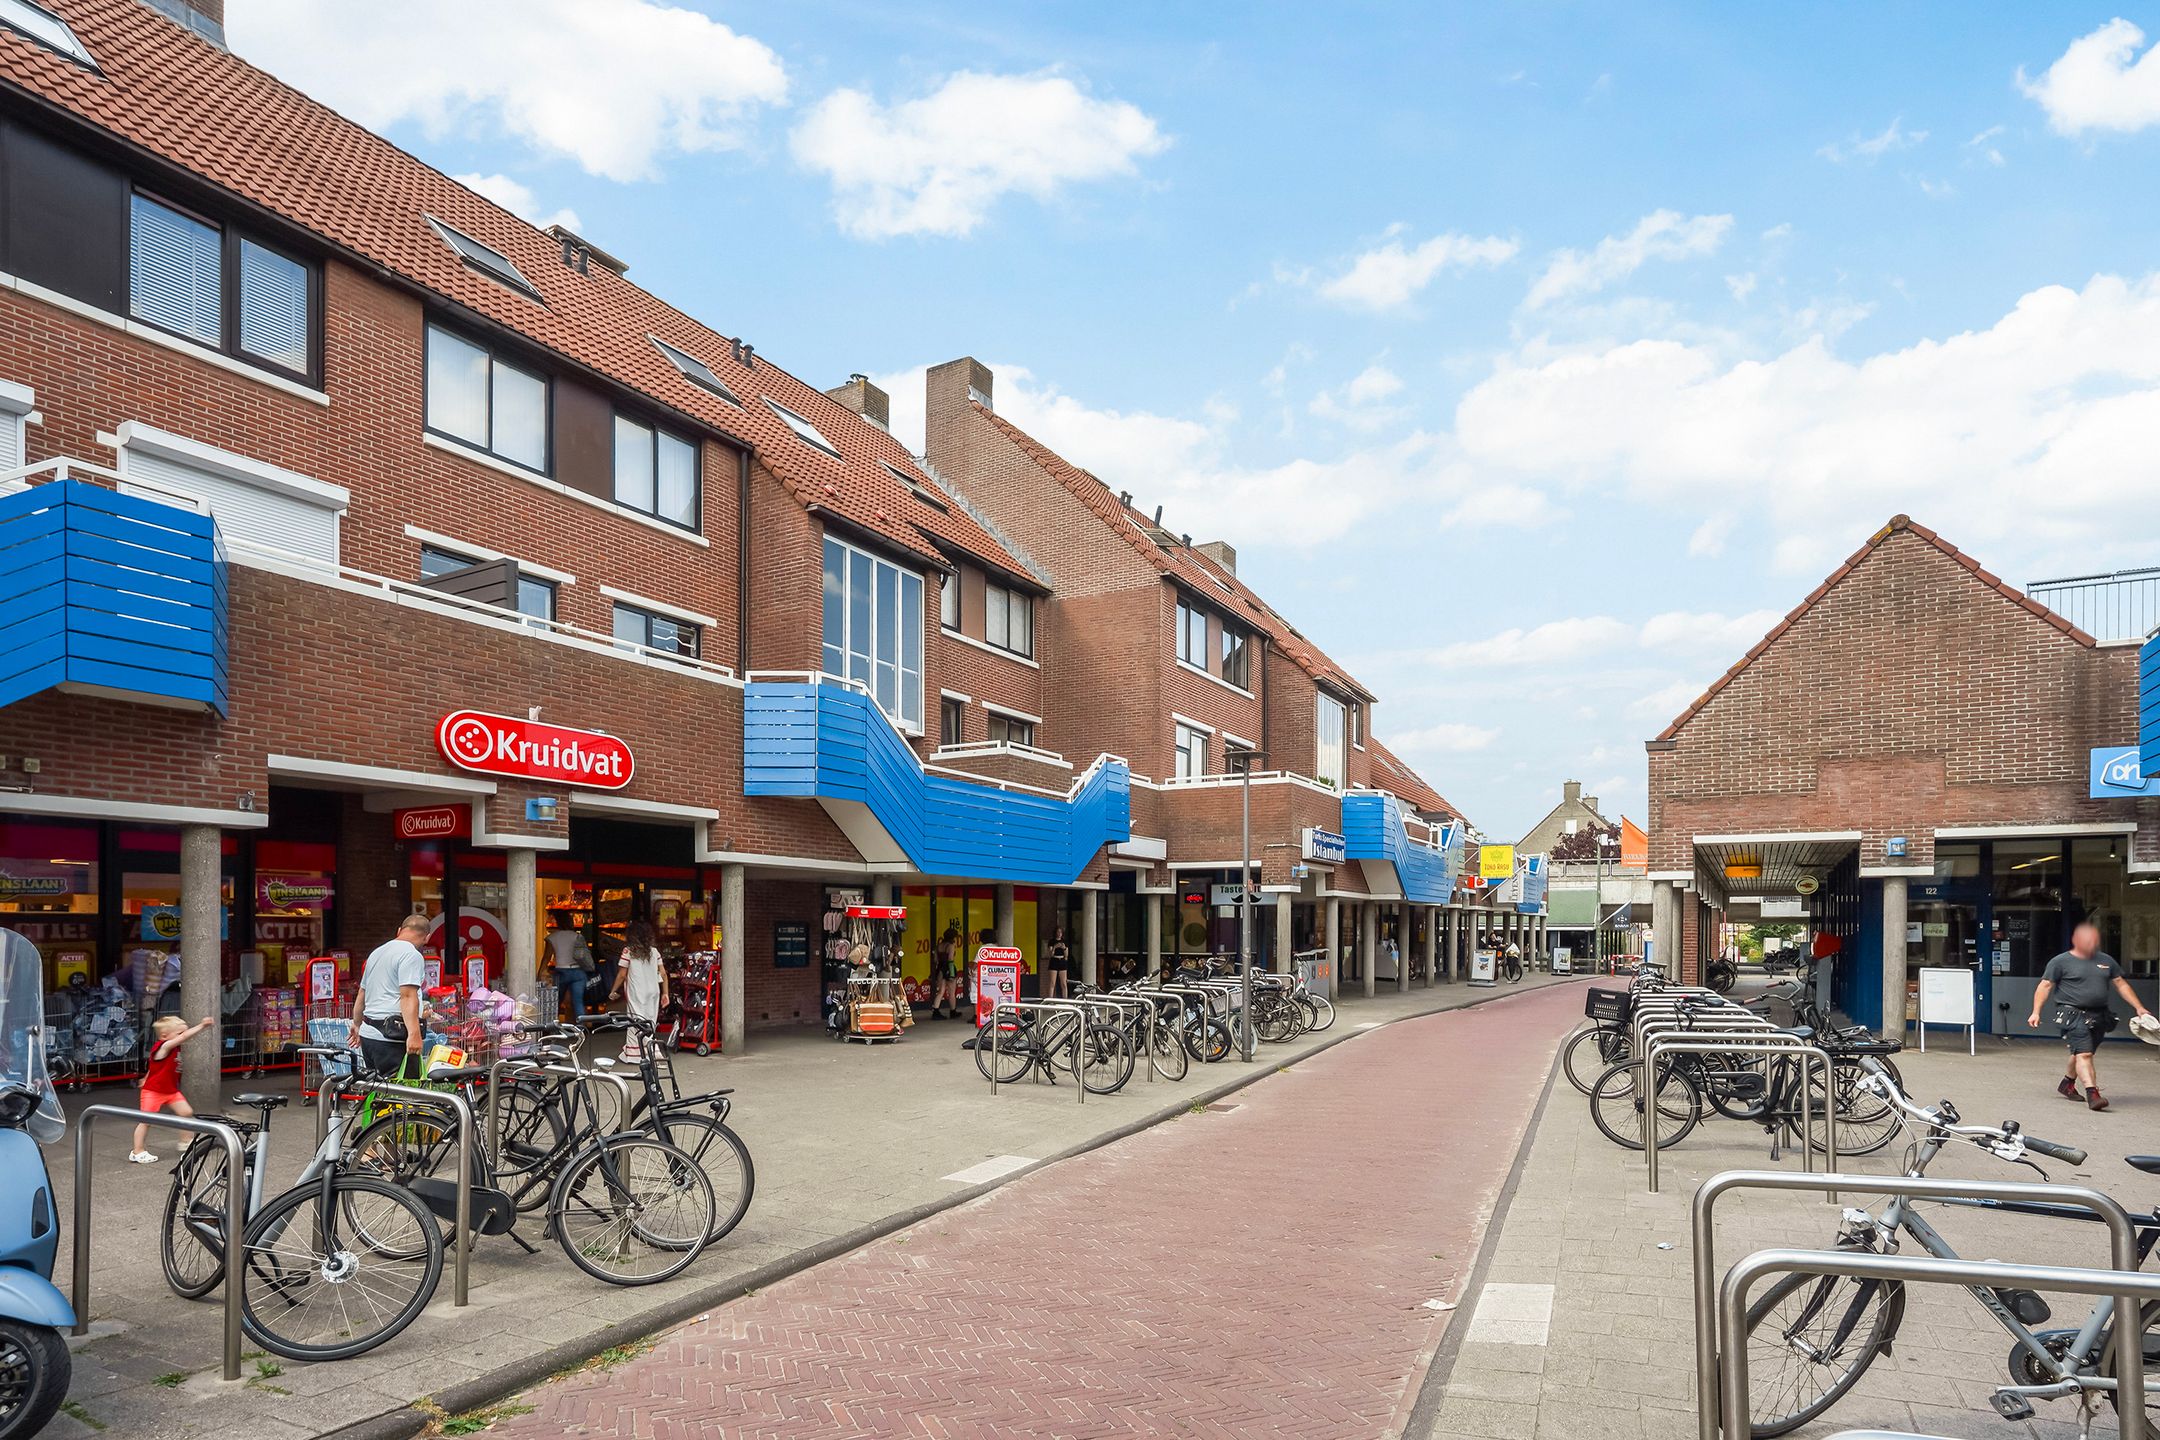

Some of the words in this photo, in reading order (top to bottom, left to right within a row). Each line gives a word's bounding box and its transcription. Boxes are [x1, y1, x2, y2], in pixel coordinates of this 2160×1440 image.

[497, 730, 622, 777] Kruidvat
[415, 815, 451, 829] Kruidvat
[1313, 842, 1345, 862] Istanbul
[1220, 885, 1243, 893] Taste
[1925, 887, 1937, 895] 122
[989, 950, 1018, 959] Kruidvat
